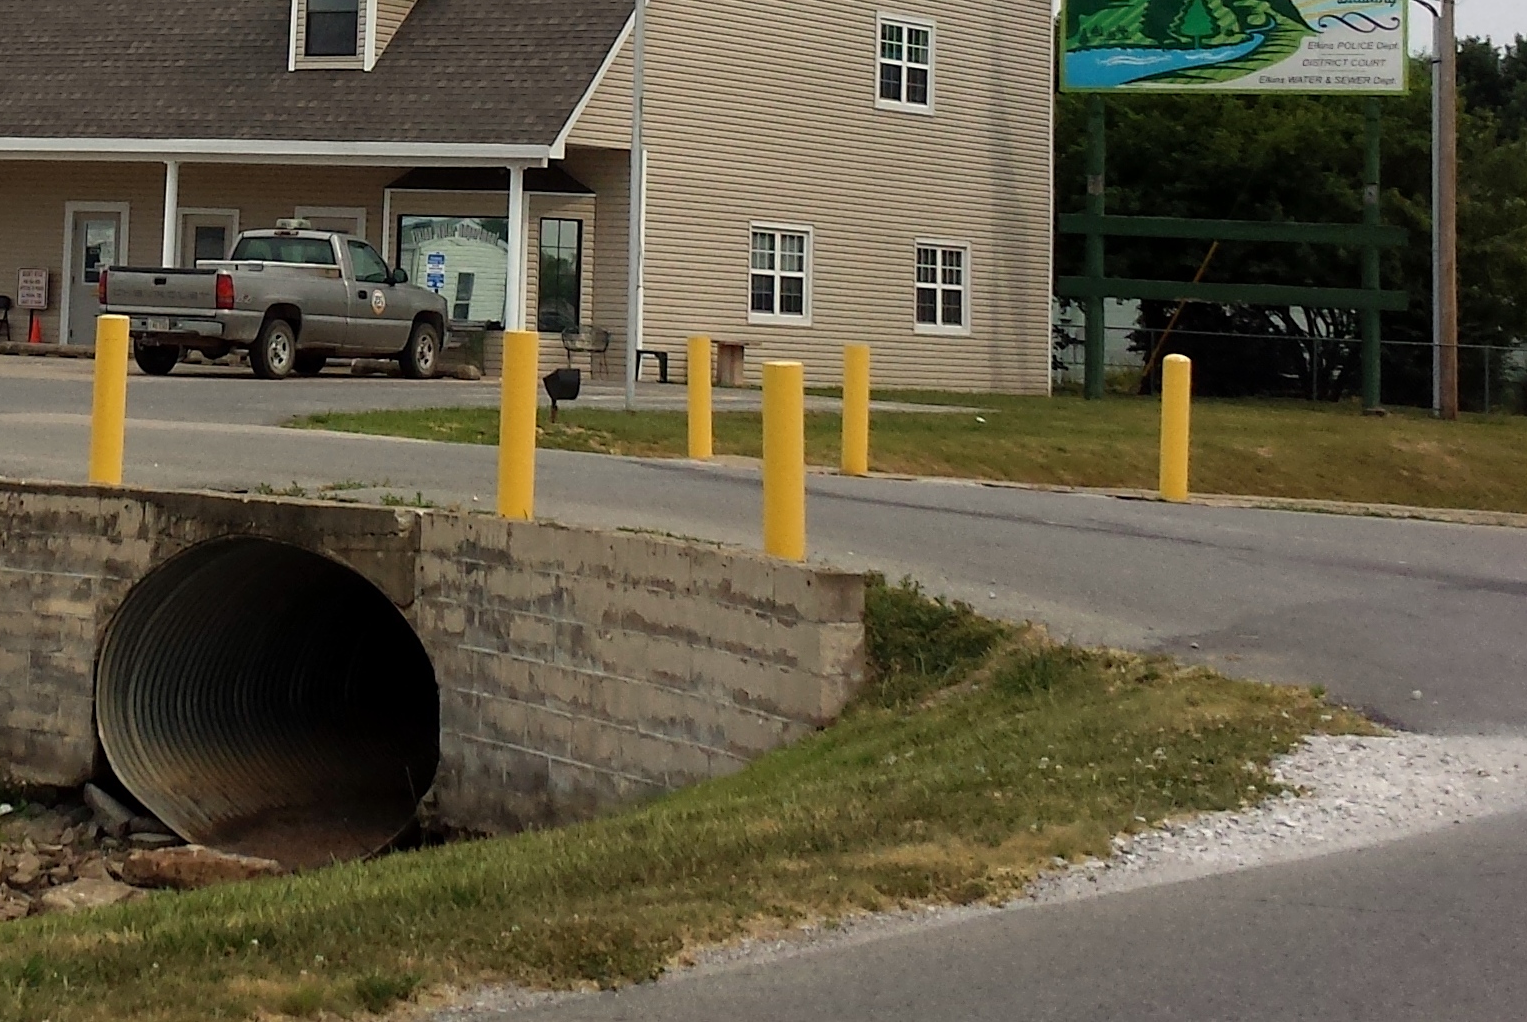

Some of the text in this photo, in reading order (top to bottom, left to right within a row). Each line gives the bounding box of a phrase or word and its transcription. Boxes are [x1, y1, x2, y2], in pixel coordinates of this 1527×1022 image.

[1336, 41, 1374, 50] POLICE
[1302, 58, 1387, 67] DISTRICT COURT
[1288, 75, 1323, 84] WATER
[1325, 75, 1333, 84] &
[1334, 75, 1371, 84] SEWER
